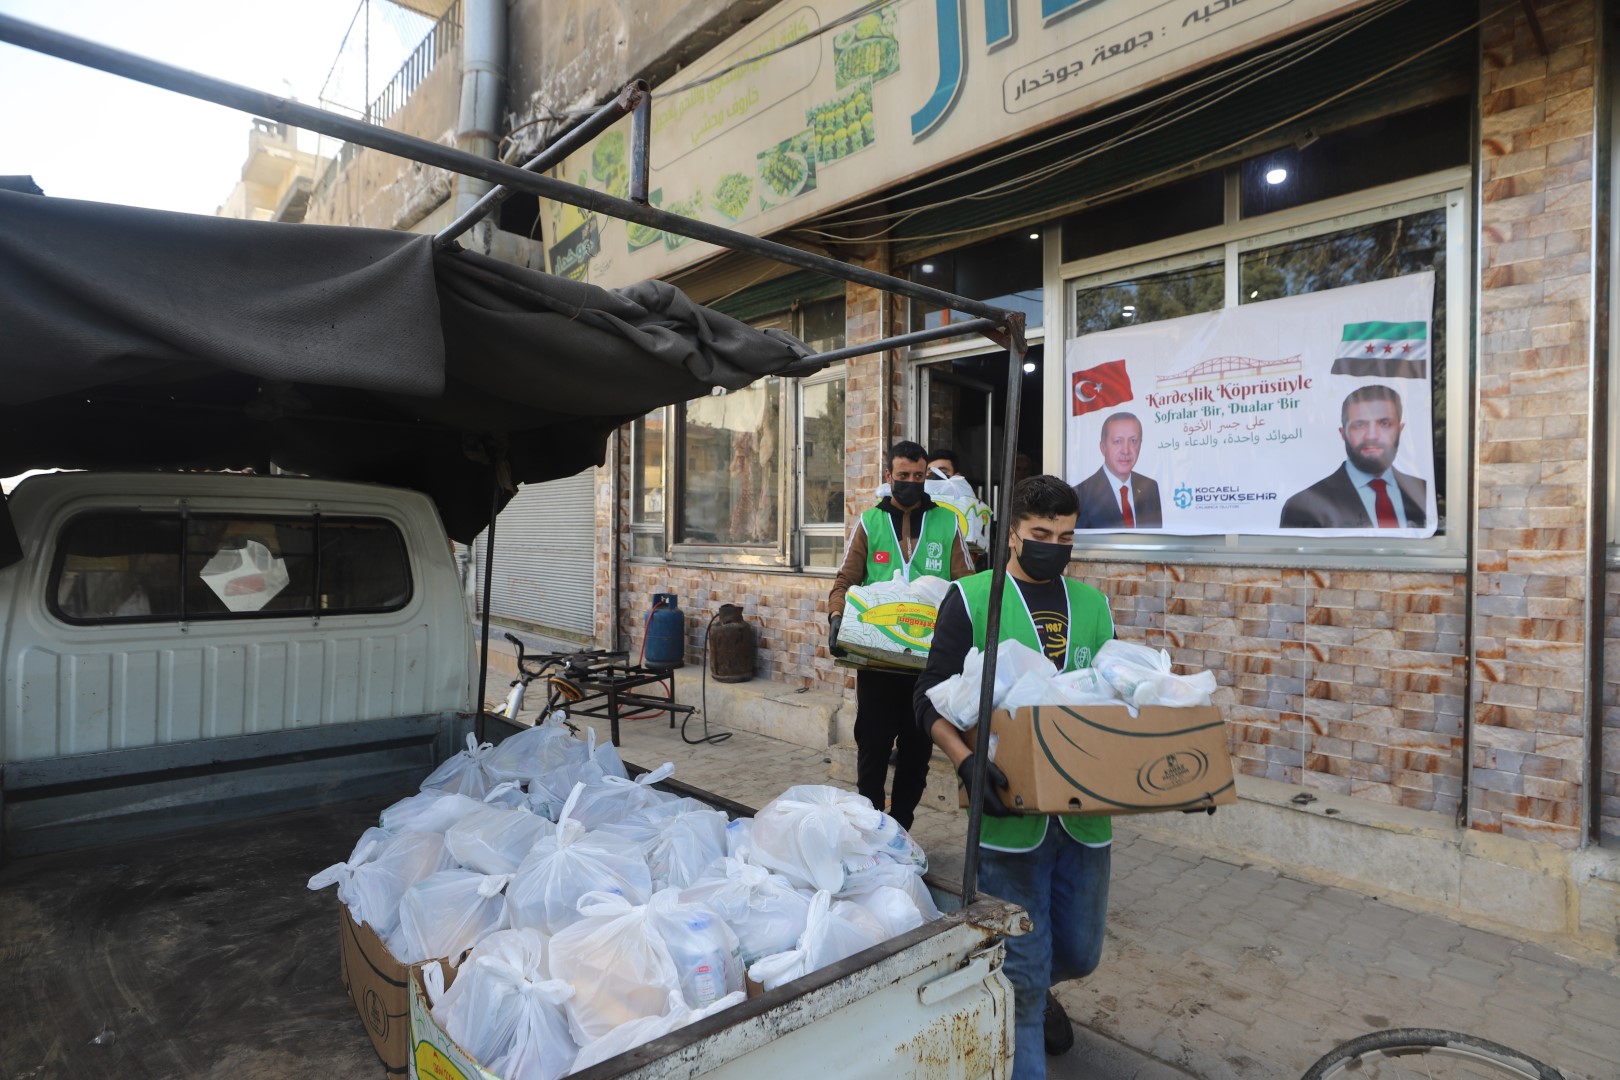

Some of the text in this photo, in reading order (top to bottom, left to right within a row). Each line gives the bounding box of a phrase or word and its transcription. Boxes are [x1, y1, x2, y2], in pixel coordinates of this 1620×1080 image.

[1091, 28, 1155, 66] جمعة
[1014, 60, 1084, 101] جوخدار
[1145, 374, 1312, 408] Kardeşlik Köprüsüyle
[1155, 398, 1300, 424] Sofralar Bir, Dualar Bir
[1217, 421, 1240, 434] جسر
[1246, 416, 1265, 430] على
[1184, 435, 1218, 447] والدعاء
[1265, 428, 1303, 443] الموائد
[1157, 438, 1180, 450] واحد
[1045, 622, 1063, 633] 1987
